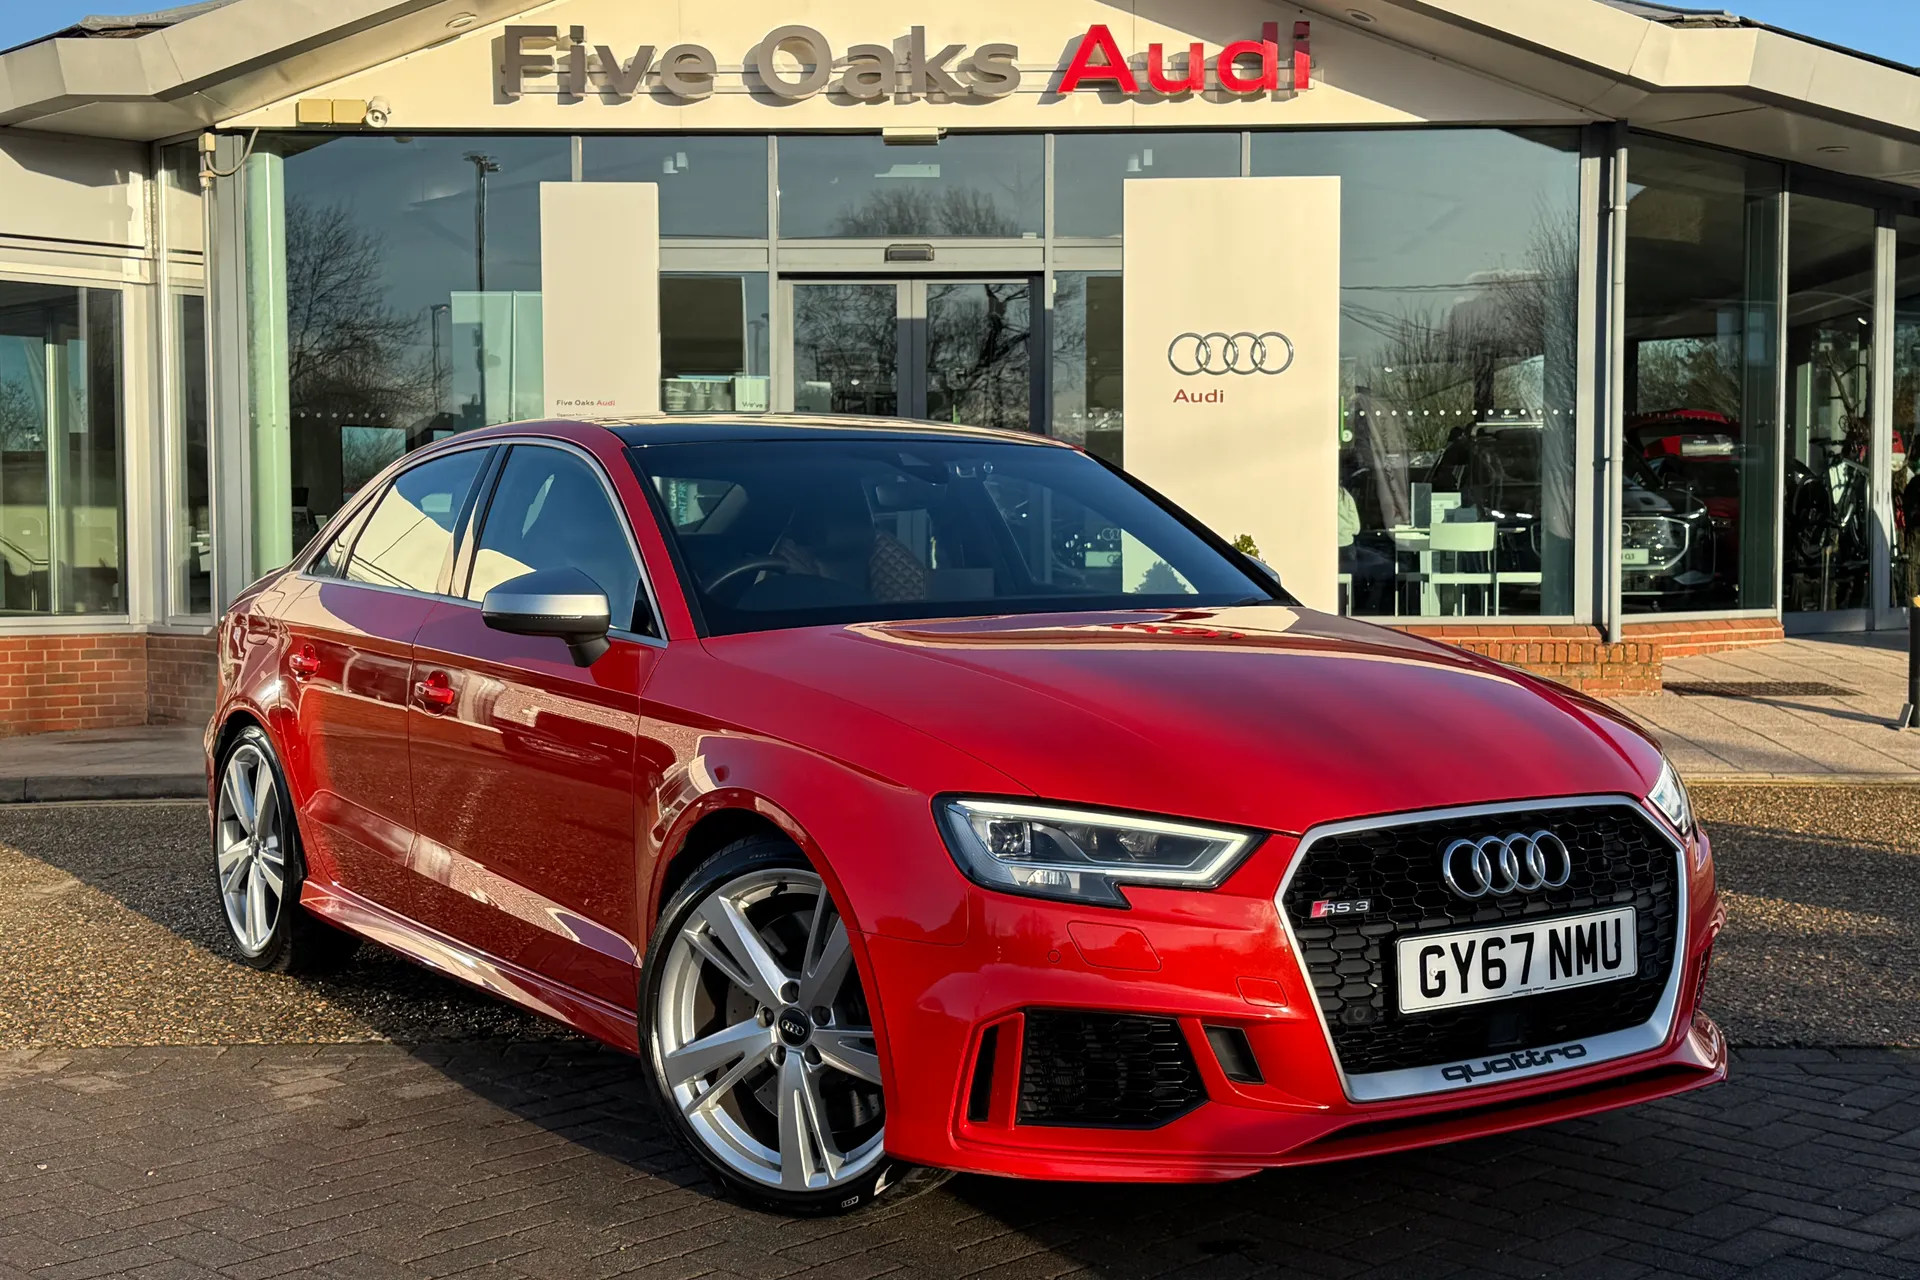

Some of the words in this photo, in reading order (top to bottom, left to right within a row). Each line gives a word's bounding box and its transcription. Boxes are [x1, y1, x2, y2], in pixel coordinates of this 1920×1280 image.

[504, 25, 717, 99] Five
[758, 25, 1020, 98] Oaks
[1057, 21, 1310, 95] Audi
[1173, 389, 1224, 403] Audi
[1320, 902, 1350, 915] RS
[1355, 900, 1369, 912] 3
[1419, 932, 1535, 999] GY67
[1548, 917, 1622, 981] NMU
[1441, 1043, 1587, 1083] quattro
